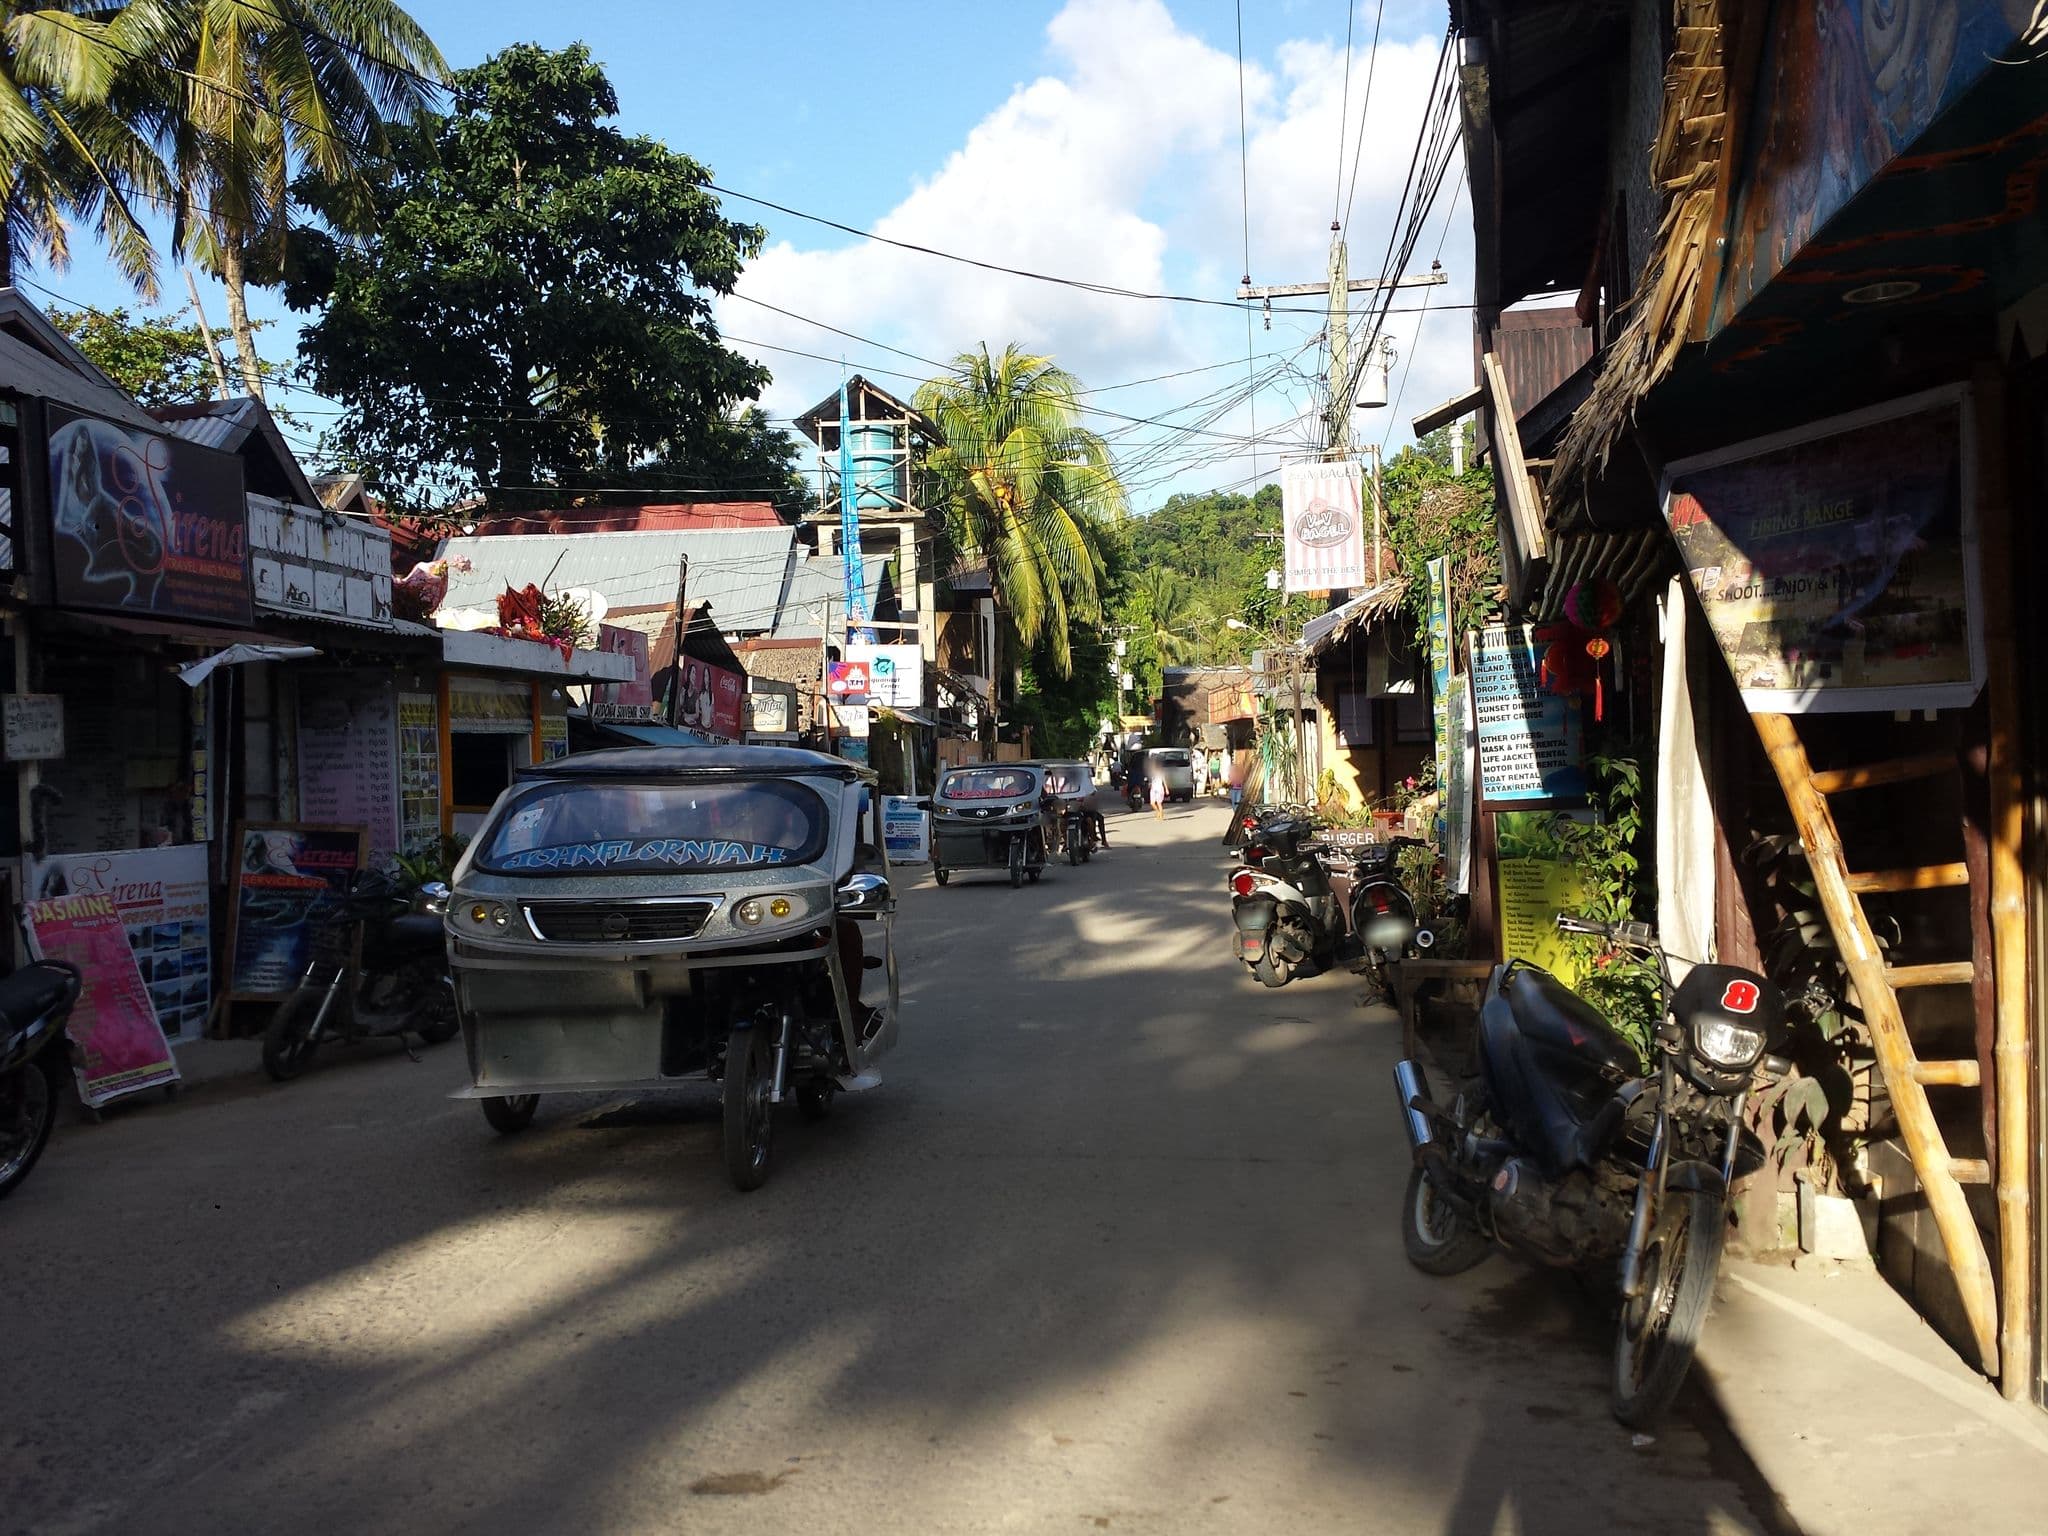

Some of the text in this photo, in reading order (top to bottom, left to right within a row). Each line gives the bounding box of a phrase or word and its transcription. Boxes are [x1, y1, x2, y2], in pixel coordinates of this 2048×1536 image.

[1750, 498, 1856, 537] FIRING RANGE
[1301, 523, 1349, 540] BAGEL
[1288, 567, 1317, 577] SIMPLY
[1322, 566, 1338, 575] THE
[1473, 628, 1526, 650] ACTIVITIES
[1474, 652, 1529, 664] ISLAND TOUR
[1475, 662, 1531, 674] INLAND TOUR
[1475, 671, 1540, 684] CLIFF CLIMBING
[1476, 685, 1499, 694] DROP
[1501, 683, 1507, 691] &
[1477, 694, 1510, 704] FISHING
[1478, 701, 1544, 714] SUNSET DINNER
[1479, 710, 1544, 723] SUNSET CRUISE
[1480, 733, 1508, 744] OTHER
[1481, 745, 1505, 754] MASK
[1516, 742, 1535, 750] FINS
[1536, 739, 1569, 749] RENTAL
[1482, 749, 1568, 764] LIFE JACKET RENTAL
[1483, 759, 1568, 774] MOTOR BIKE RENTAL
[1484, 772, 1541, 783] BOAT RENTAL
[1485, 785, 1514, 793] KAYAK
[1320, 832, 1375, 846] BURGER
[503, 839, 787, 870] JOHNFLORNIAH
[33, 895, 115, 924] JASMINE
[1721, 979, 1760, 1013] 8
